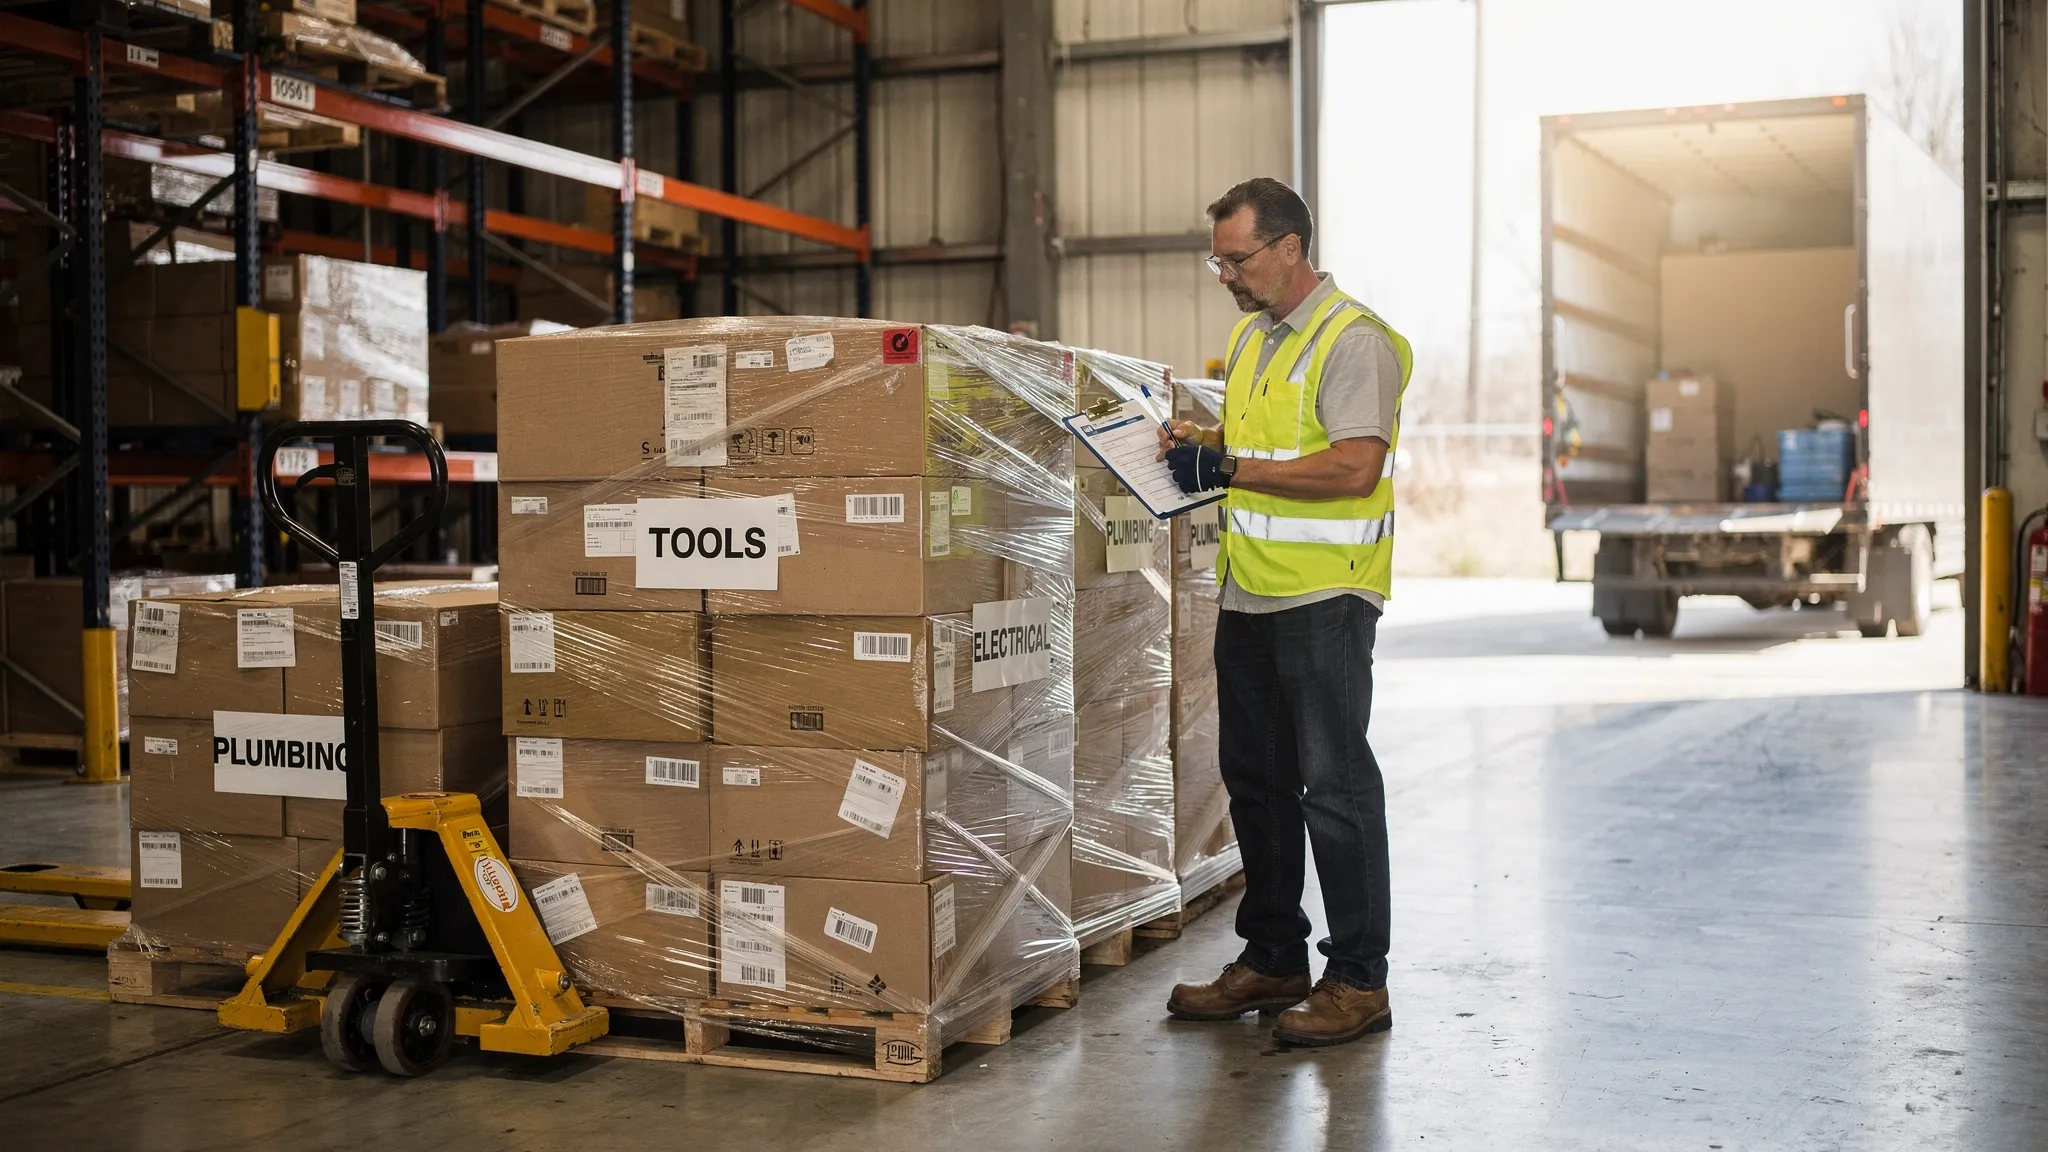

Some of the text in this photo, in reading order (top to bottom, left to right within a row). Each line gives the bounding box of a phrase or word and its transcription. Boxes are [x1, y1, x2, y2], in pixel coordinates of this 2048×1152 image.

[648, 526, 767, 560] TOOLS
[1106, 518, 1154, 546] PLUMBING
[973, 622, 1051, 663] ELECTRICAL
